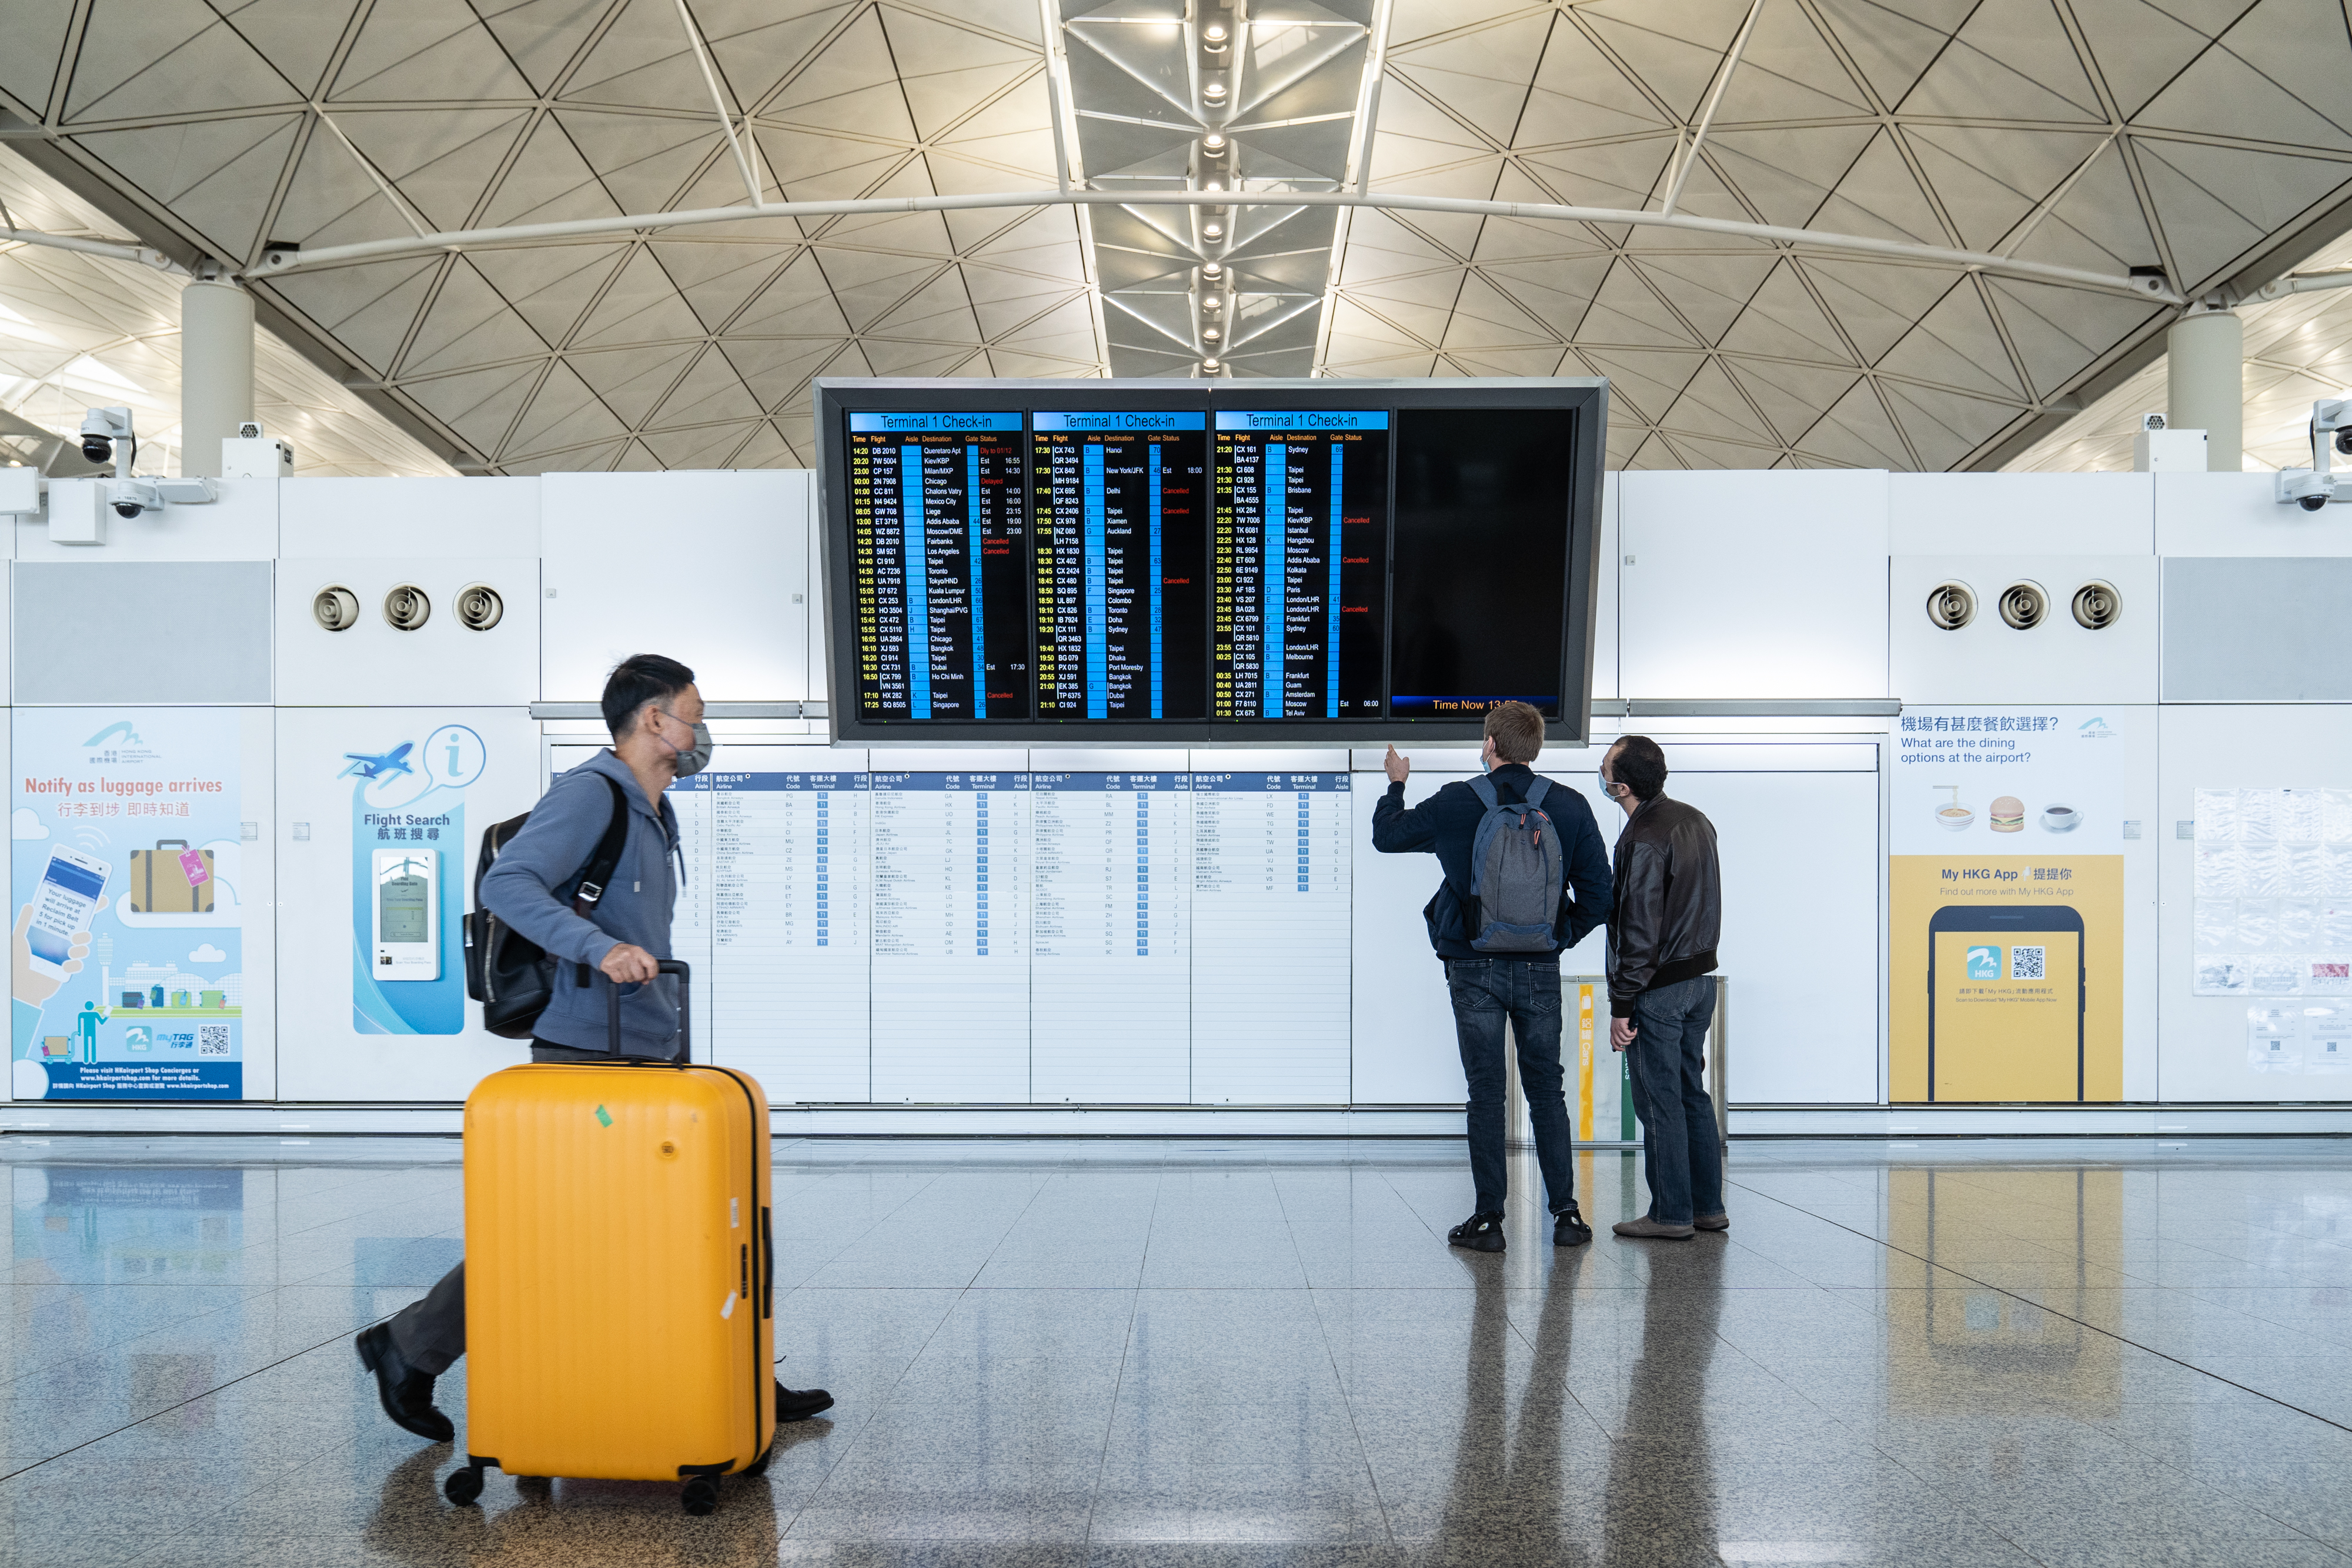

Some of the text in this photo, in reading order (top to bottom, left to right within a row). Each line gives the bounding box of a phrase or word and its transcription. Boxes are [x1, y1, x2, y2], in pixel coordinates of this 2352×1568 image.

[880, 414, 991, 427] Terminal 1 Check-in
[1064, 414, 1174, 427] Terminal 1 Check-in
[1247, 413, 1357, 426] Terminal 1 Check-in
[1433, 700, 1518, 710] Time Now 13:
[1900, 716, 2058, 731] 機場有甚麼餐飲選擇?
[1901, 738, 1931, 747] What
[1957, 738, 1975, 747] the
[1980, 738, 2014, 750] dining
[1901, 753, 2030, 764] options at the airport?
[26, 777, 222, 796] Notify as luggage arrives
[58, 802, 189, 817] 行李到埗 即時知道
[364, 814, 450, 828] Flight Search
[377, 828, 439, 840] 航班搜尋
[1942, 870, 1959, 881] My
[1994, 870, 2017, 881] App
[2034, 868, 2072, 880] 提提你
[48, 888, 86, 908] Your luggage
[2019, 888, 2031, 897] My
[2034, 887, 2053, 895] HKG
[2056, 888, 2073, 897] App
[56, 901, 73, 911] arrive
[42, 904, 79, 922] Reclaim Belt
[48, 924, 69, 937] minute.
[1974, 969, 1995, 978] HKG
[1582, 1042, 1591, 1066] Cans
